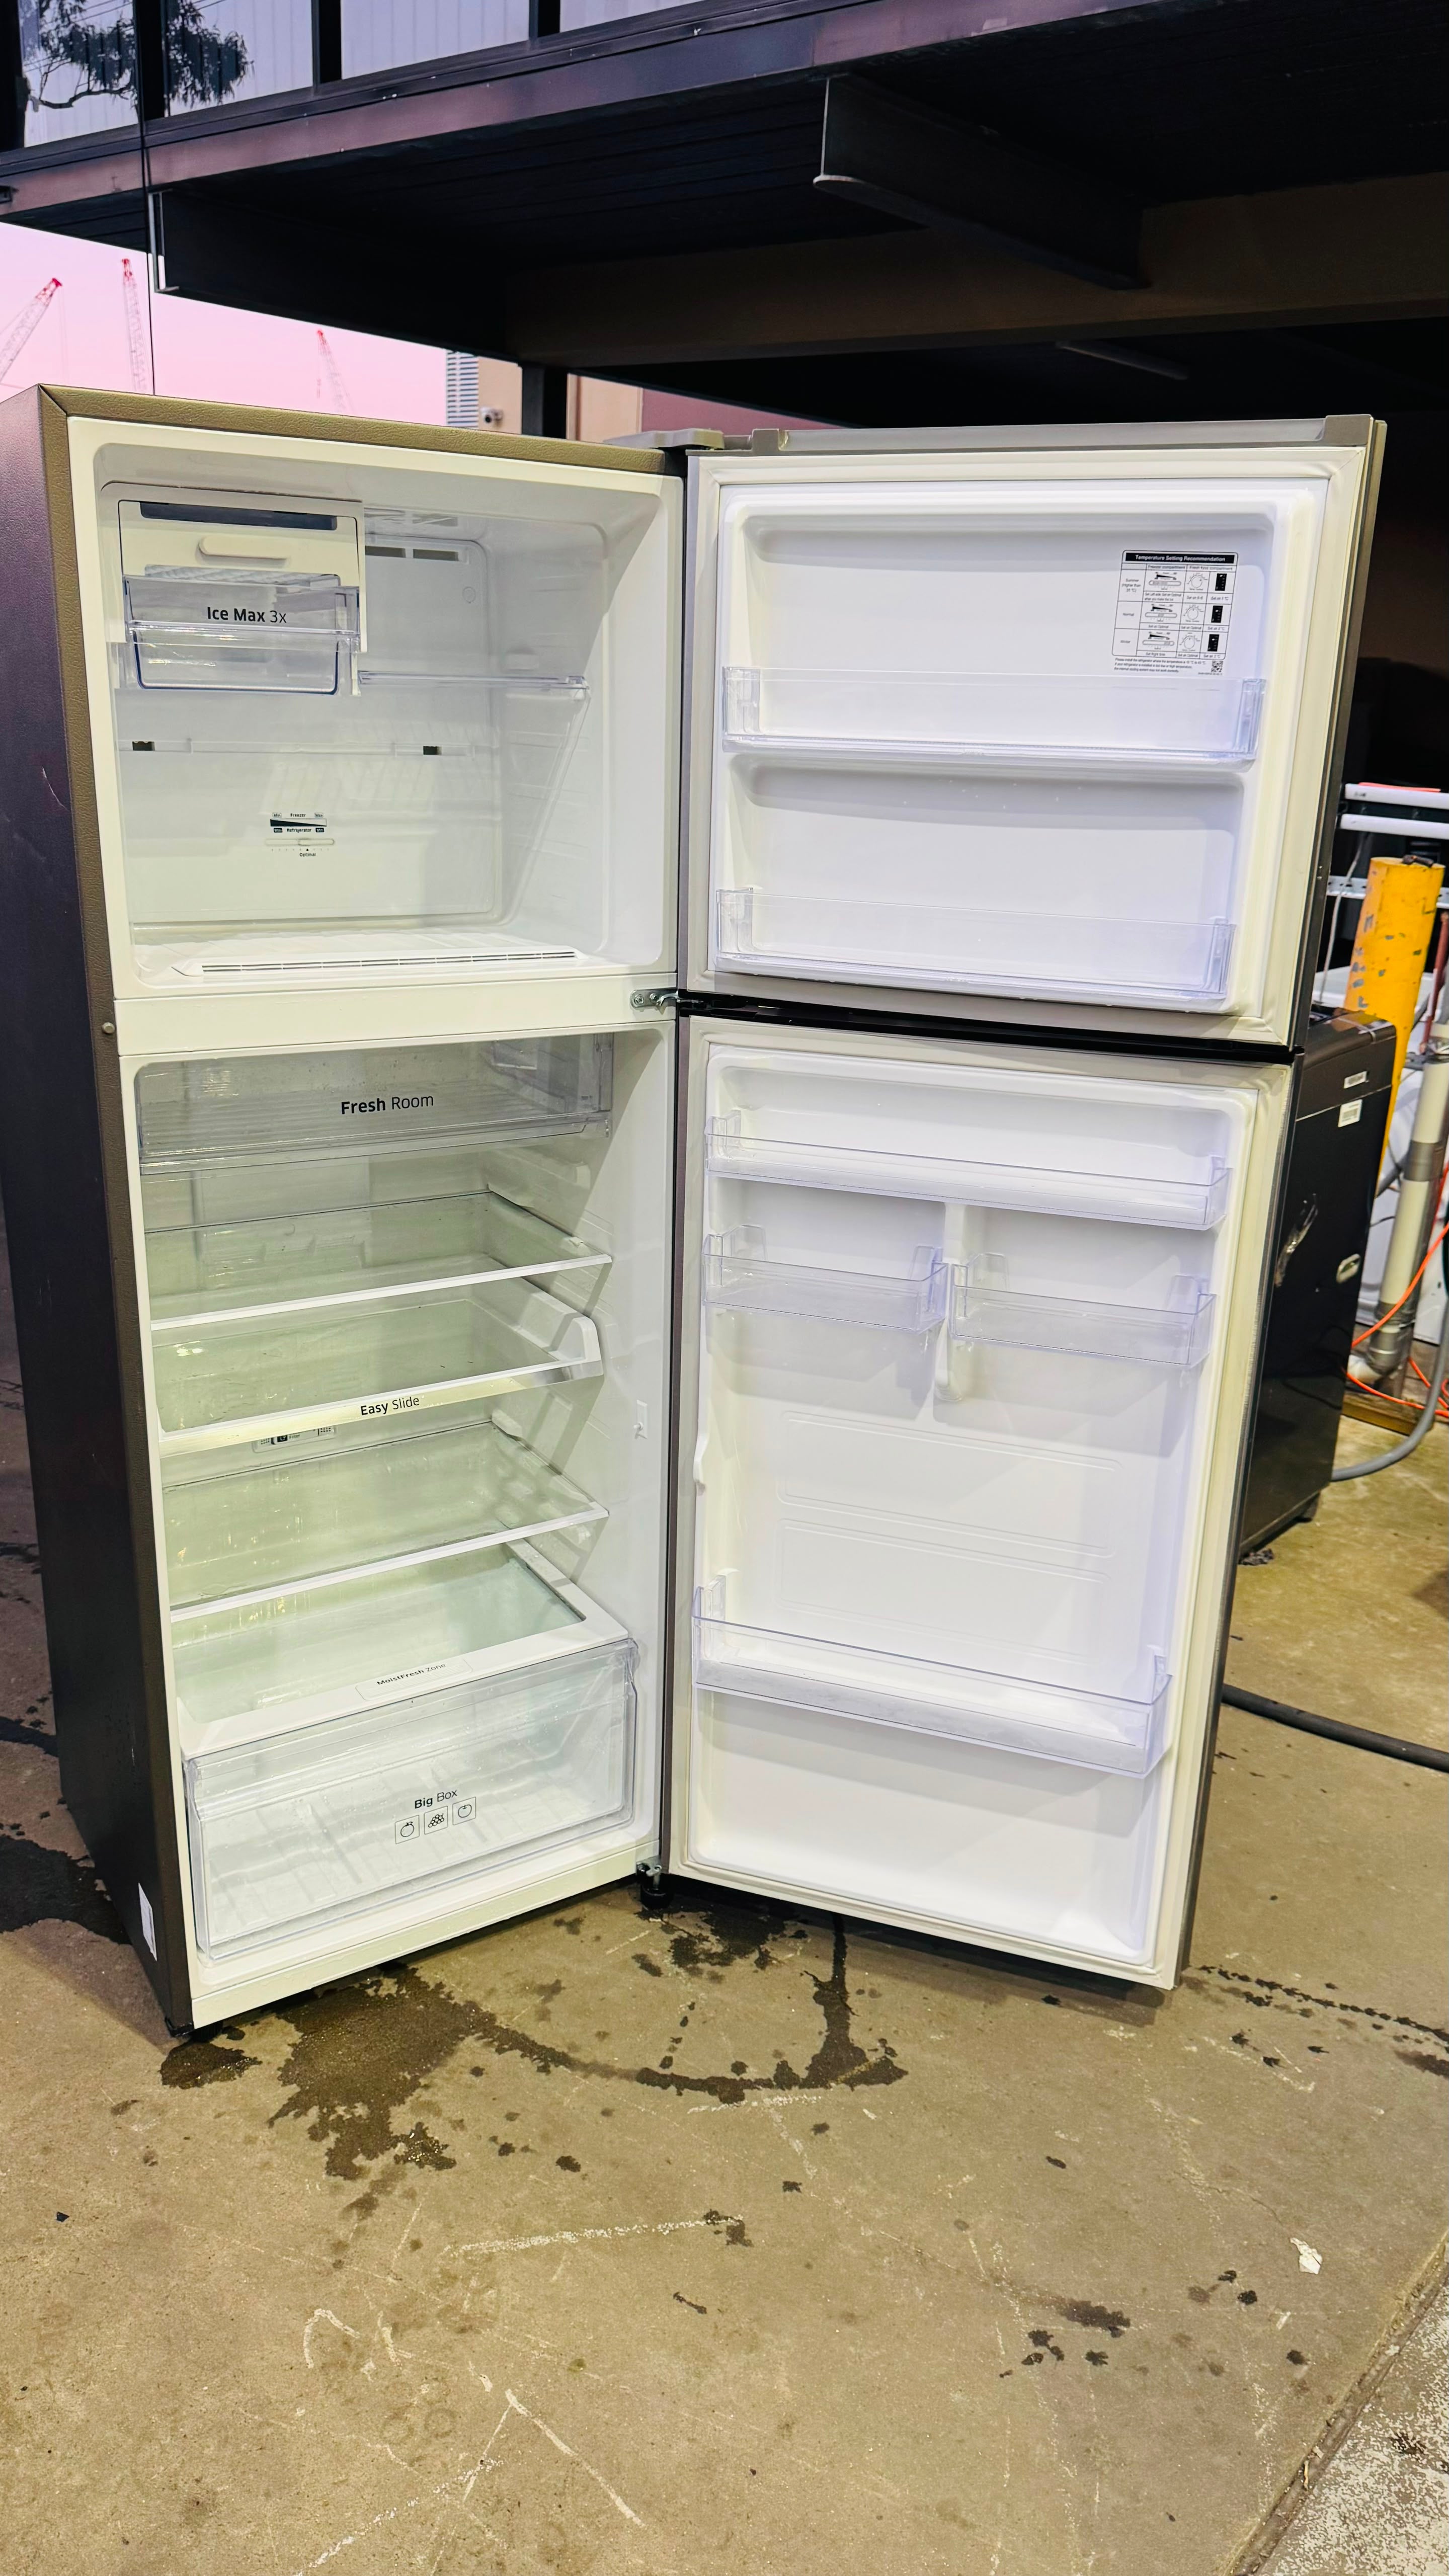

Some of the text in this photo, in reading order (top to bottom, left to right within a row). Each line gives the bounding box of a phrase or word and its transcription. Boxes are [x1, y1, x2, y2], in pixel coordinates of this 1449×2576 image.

[207, 607, 287, 623] Ice Max 3x
[341, 1095, 433, 1114] Fresh Room
[360, 1396, 420, 1415] Easy Slide
[376, 1663, 446, 1685] MoistFresh Zone
[415, 1790, 457, 1809] Big Box
